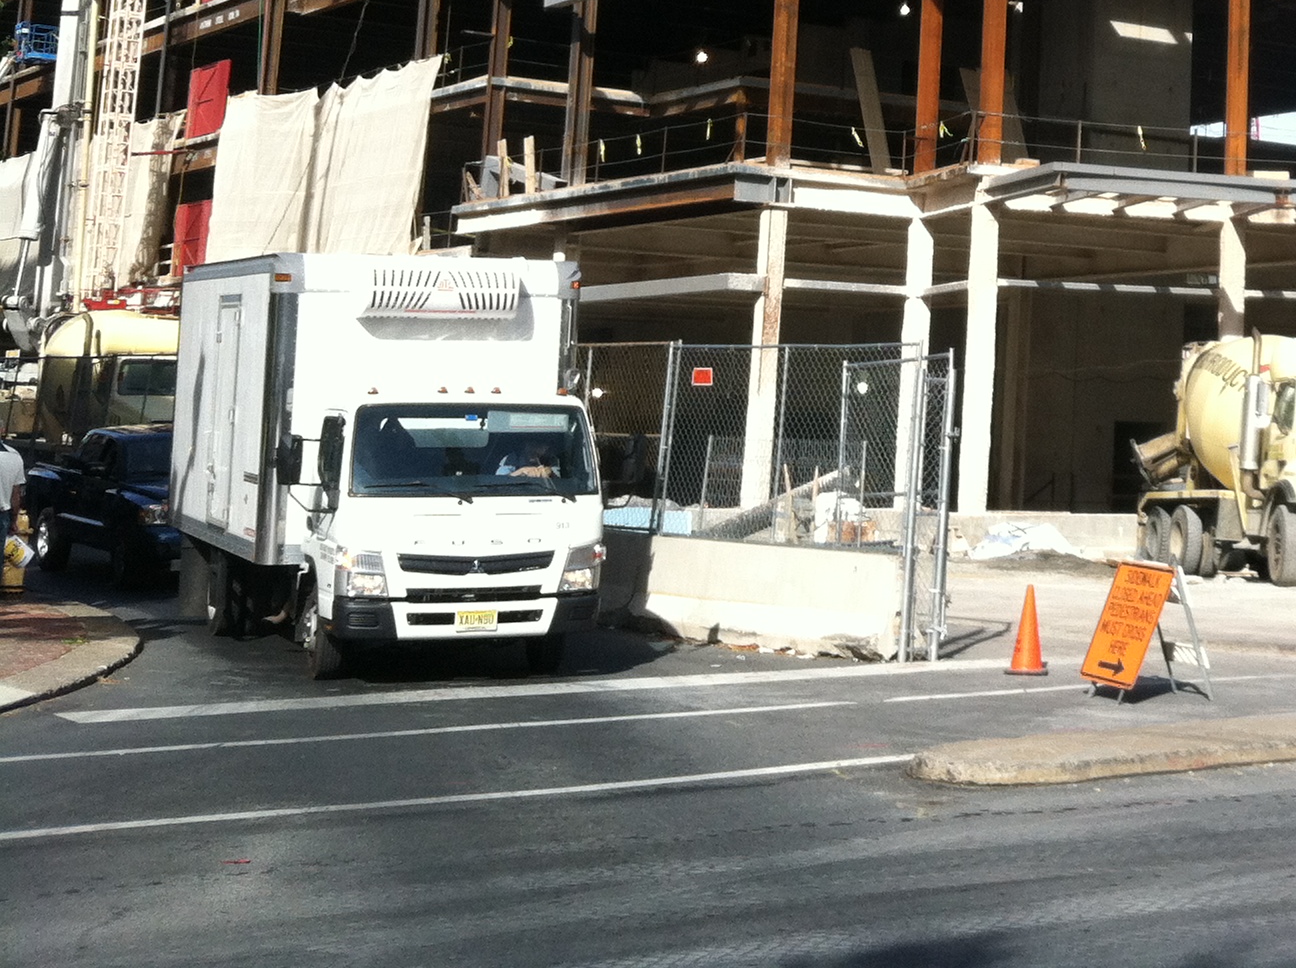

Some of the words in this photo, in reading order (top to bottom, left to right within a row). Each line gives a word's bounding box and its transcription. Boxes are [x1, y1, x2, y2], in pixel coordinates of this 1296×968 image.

[1138, 590, 1162, 608] AHEAD
[1100, 619, 1125, 636] MUST
[1121, 623, 1147, 642] CROSS
[1107, 639, 1128, 657] HERE
